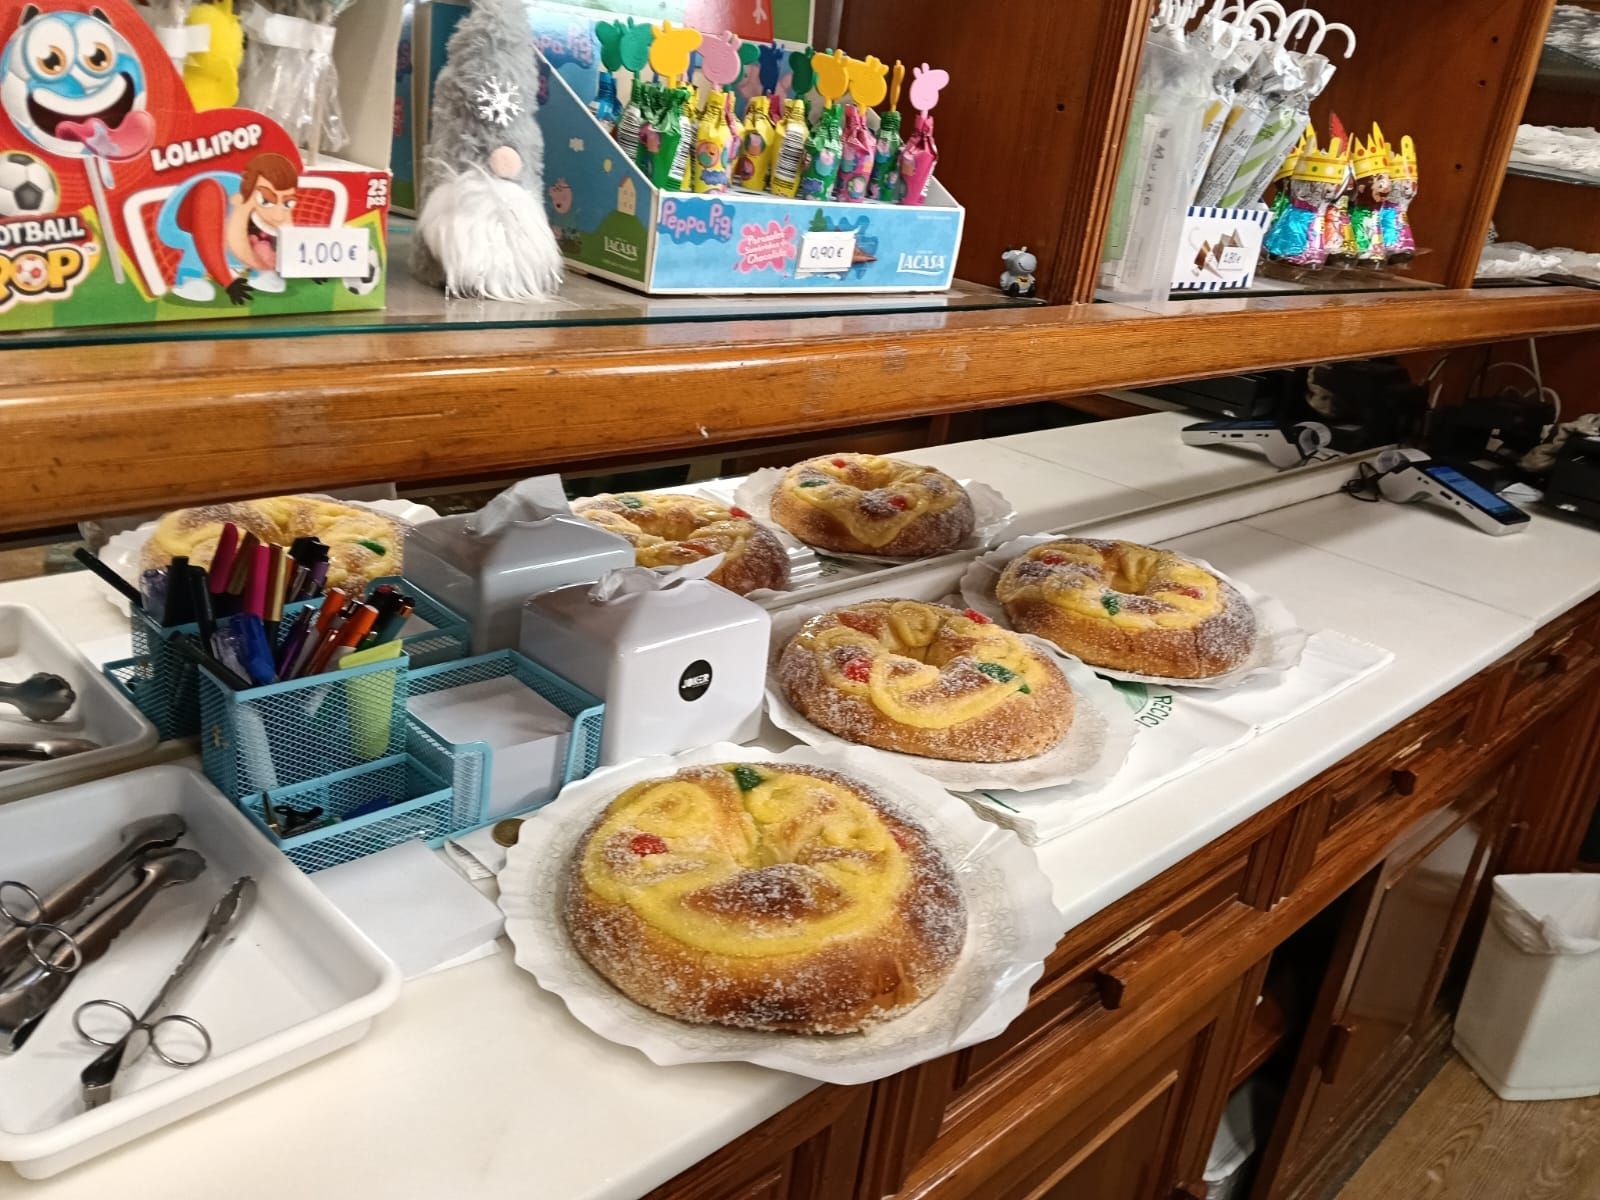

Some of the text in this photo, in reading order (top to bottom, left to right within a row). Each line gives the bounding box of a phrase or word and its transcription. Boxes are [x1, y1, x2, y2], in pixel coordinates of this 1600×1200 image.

[151, 124, 262, 172] LOLLIPOP
[367, 178, 388, 195] 25
[366, 196, 387, 209] pcs
[662, 200, 732, 240] Peppa Pig
[299, 241, 358, 265] 1,00 €
[810, 246, 845, 260] 0,90 €
[896, 252, 945, 274] LACASA
